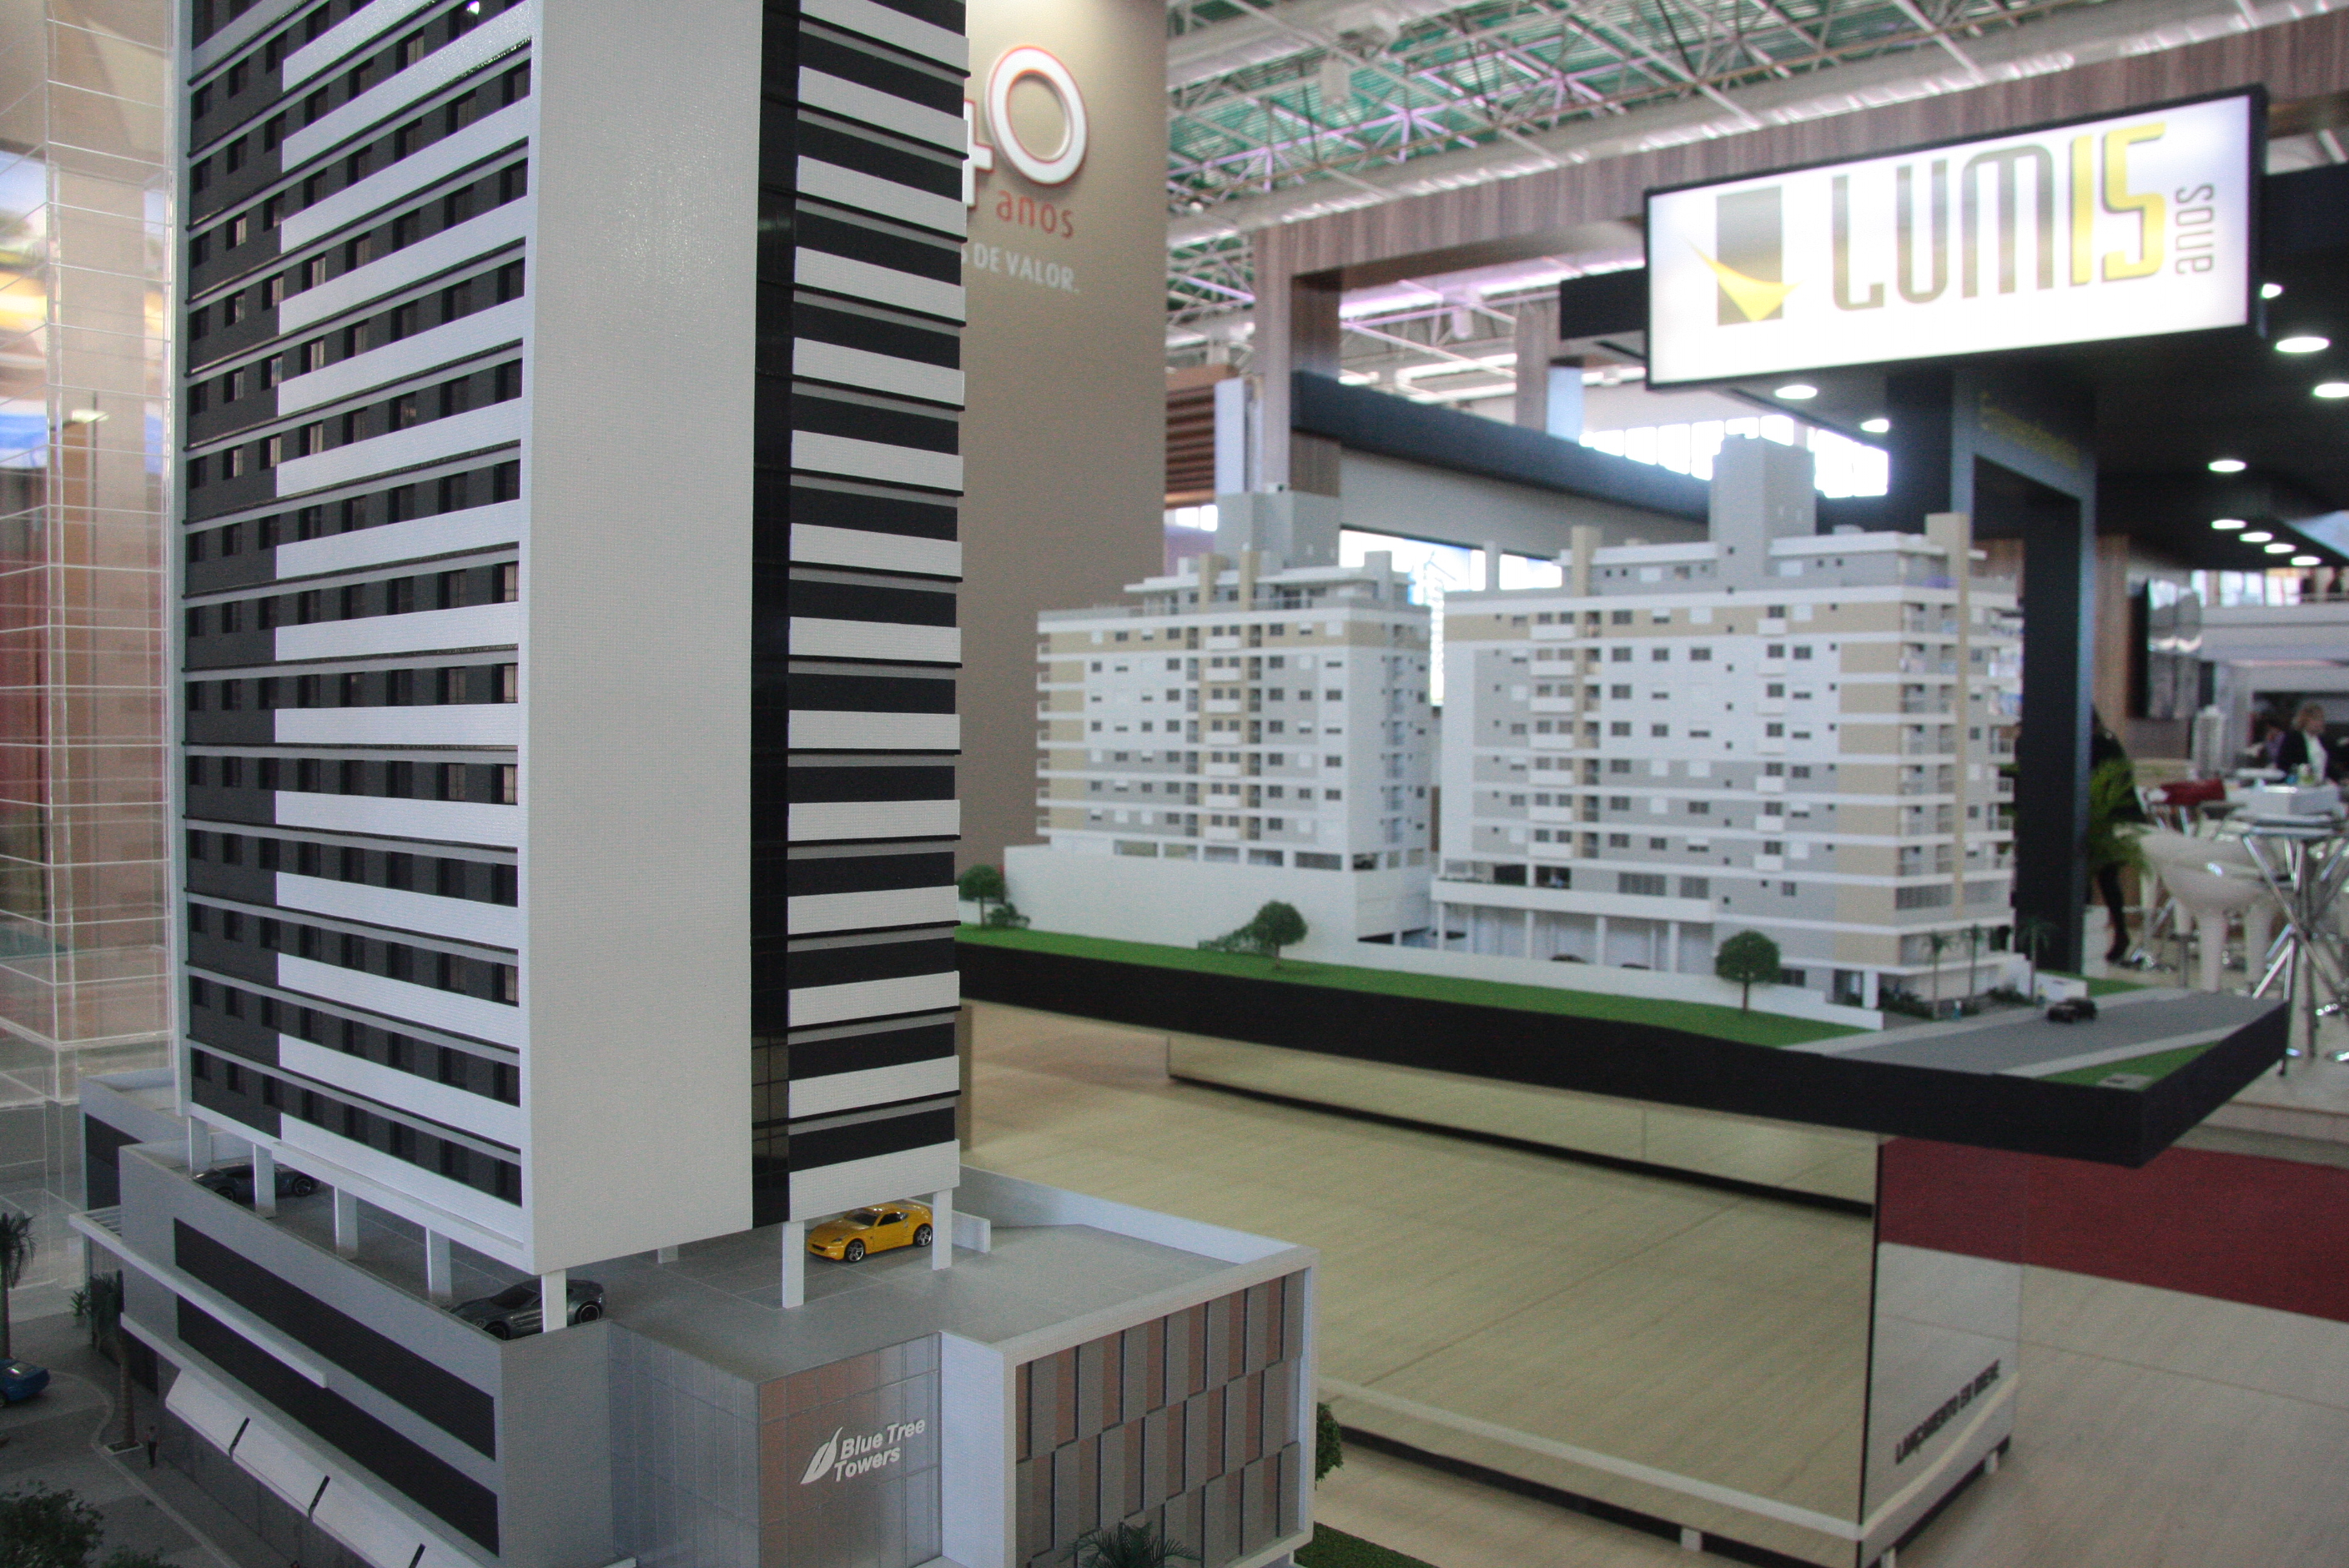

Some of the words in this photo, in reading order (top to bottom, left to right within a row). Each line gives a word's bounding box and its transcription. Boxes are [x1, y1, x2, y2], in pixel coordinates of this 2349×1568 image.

[996, 190, 1074, 239] anos
[2175, 183, 2214, 274] anos
[973, 244, 1001, 273] DE
[841, 1434, 883, 1460] Blue
[887, 1420, 925, 1444] Tree
[835, 1447, 901, 1482] Towers
